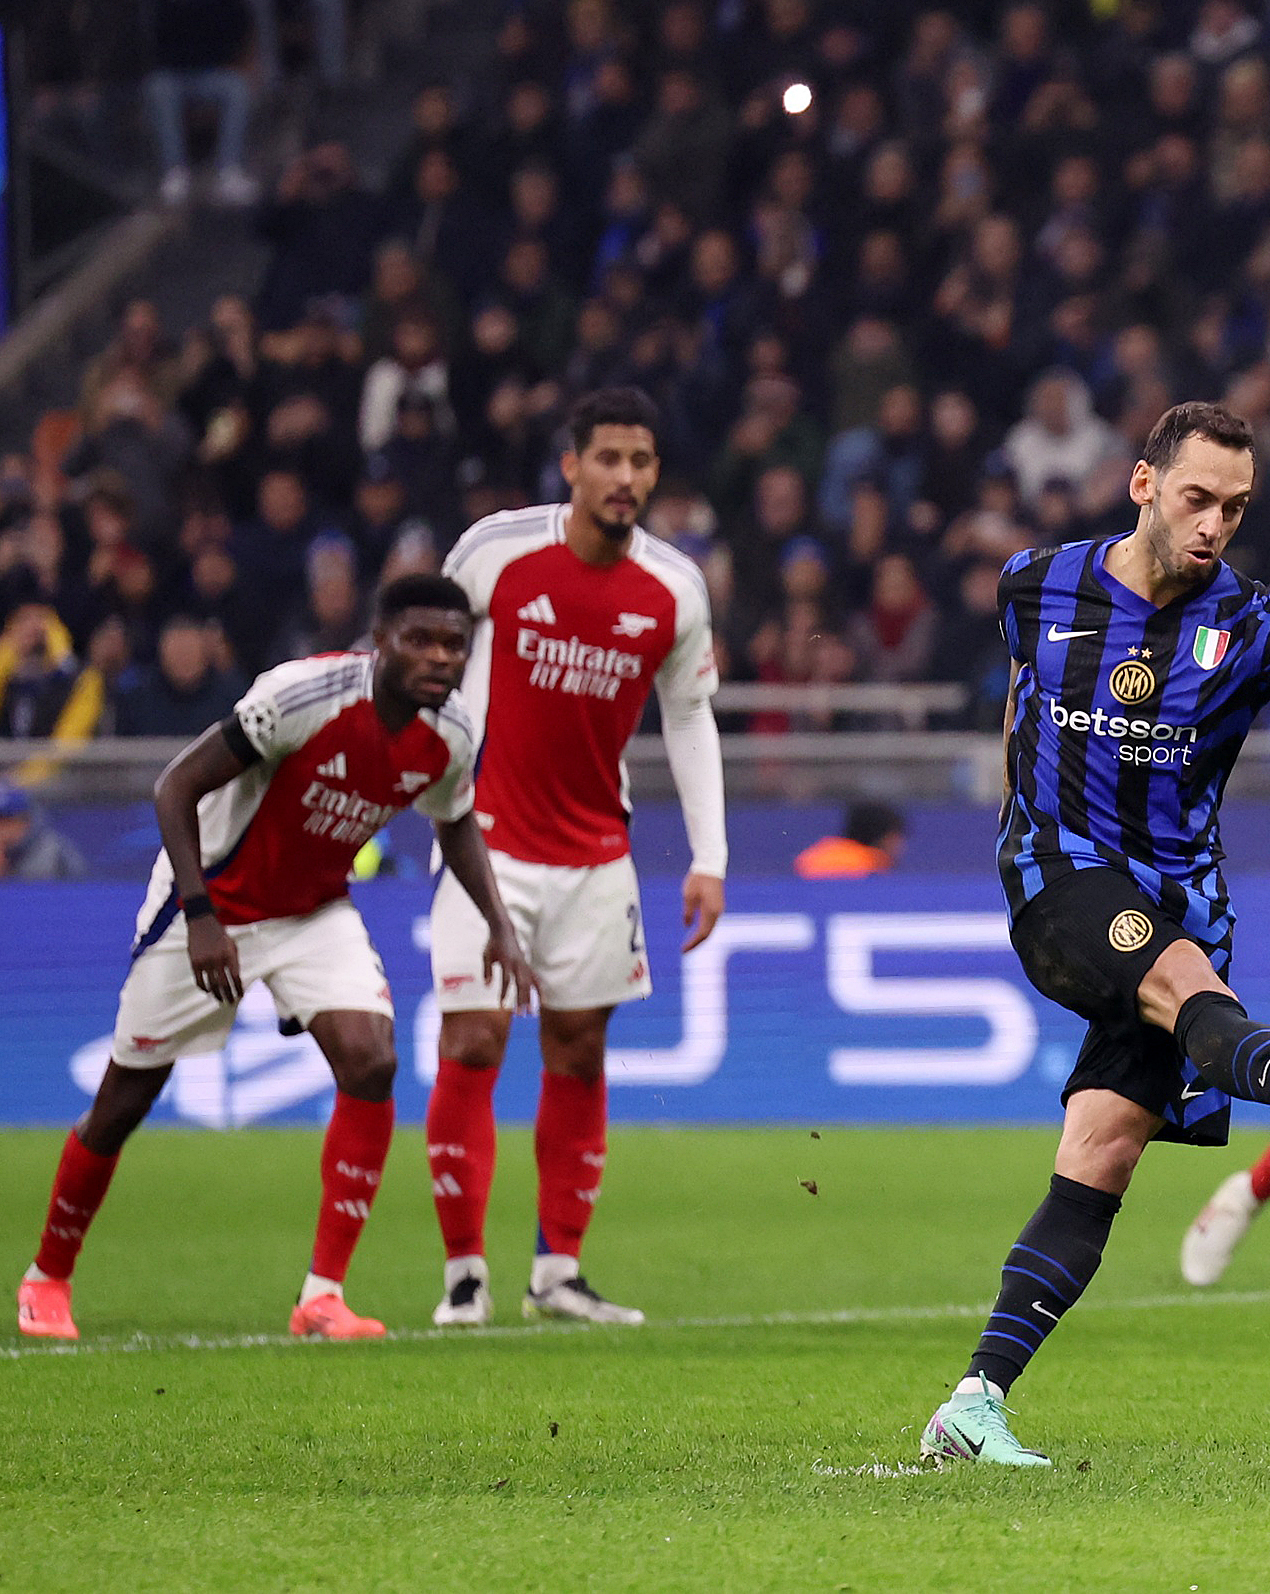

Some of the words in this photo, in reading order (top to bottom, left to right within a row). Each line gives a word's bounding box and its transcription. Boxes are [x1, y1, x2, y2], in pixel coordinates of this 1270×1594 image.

[517, 627, 643, 679] Emirates
[1050, 697, 1197, 743] betsson
[1112, 744, 1193, 766] .sport
